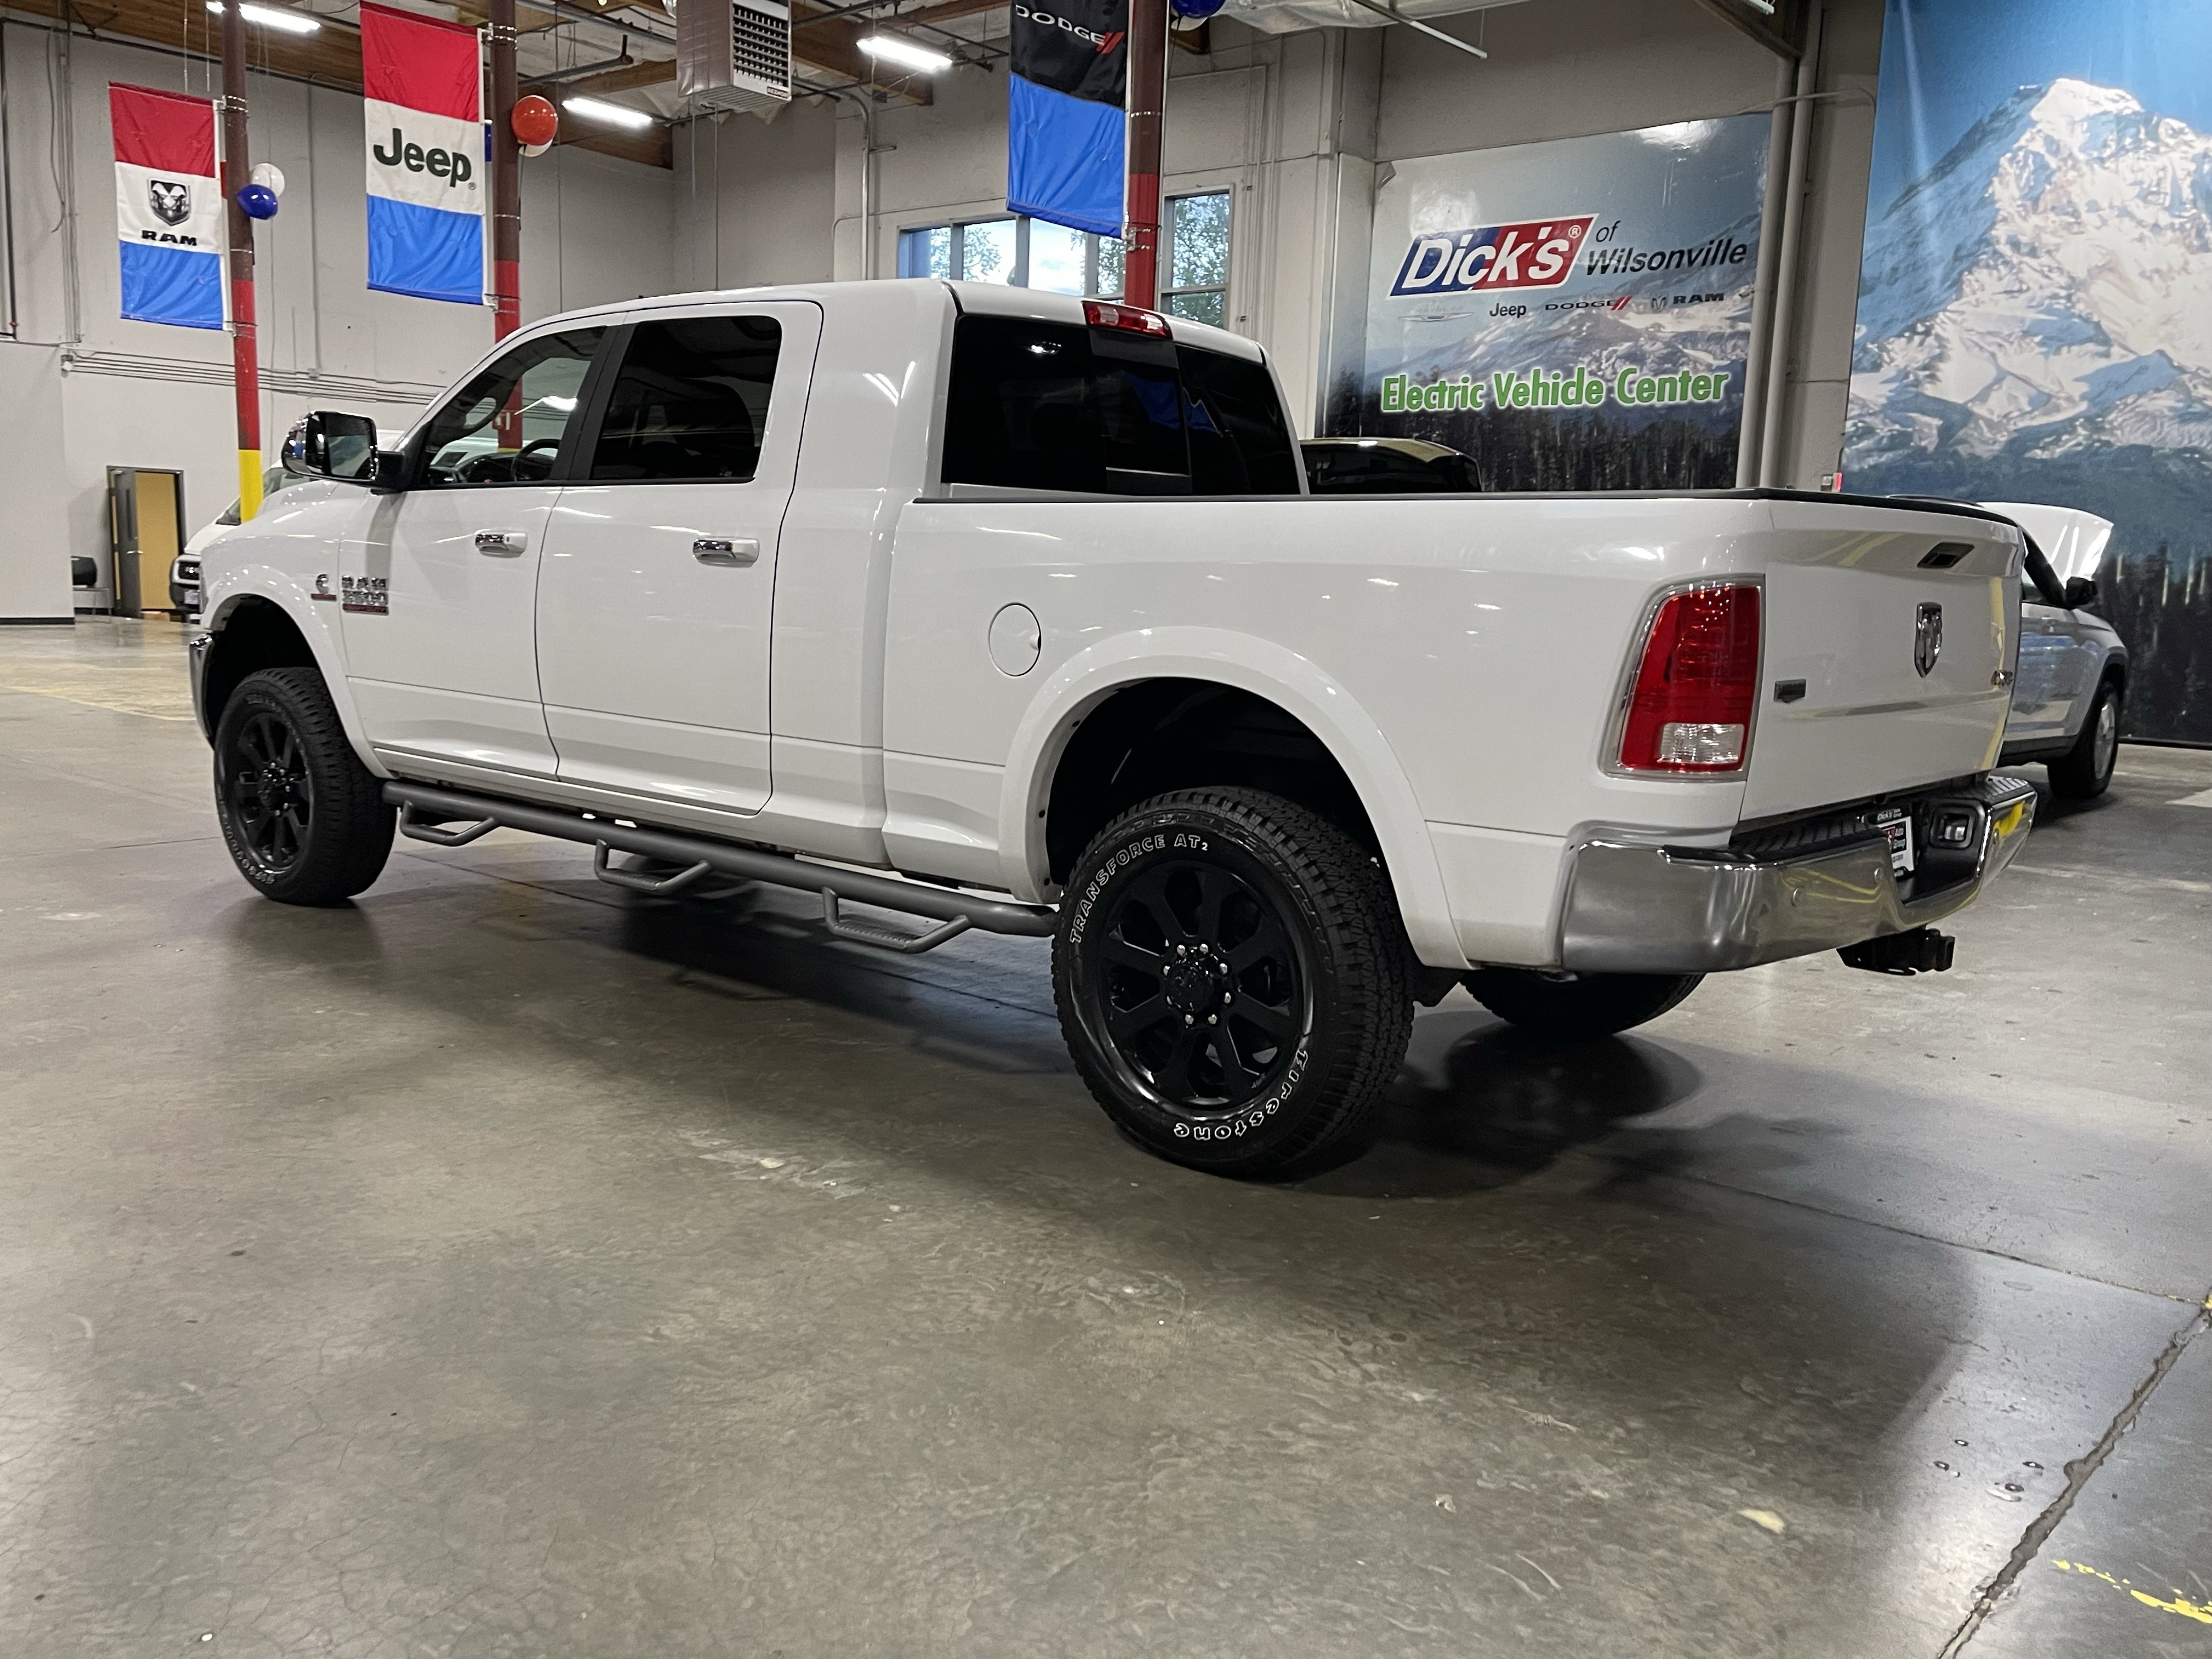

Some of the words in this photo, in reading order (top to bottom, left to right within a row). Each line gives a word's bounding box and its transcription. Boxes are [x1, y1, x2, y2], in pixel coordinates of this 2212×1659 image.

[1015, 4, 1106, 46] DODGE
[373, 127, 472, 188] Jeep
[141, 229, 198, 246] RAM
[1595, 220, 1621, 242] of
[1586, 238, 1748, 276] Wilsonville
[1489, 302, 1527, 318] Jeep
[1545, 300, 1617, 311] DODGE
[1673, 292, 1724, 304] RAM
[1383, 374, 1484, 411] Electric
[1493, 366, 1604, 407] Vehicle
[1617, 368, 1729, 404] Center
[1069, 834, 1165, 944] TRANSFORCE
